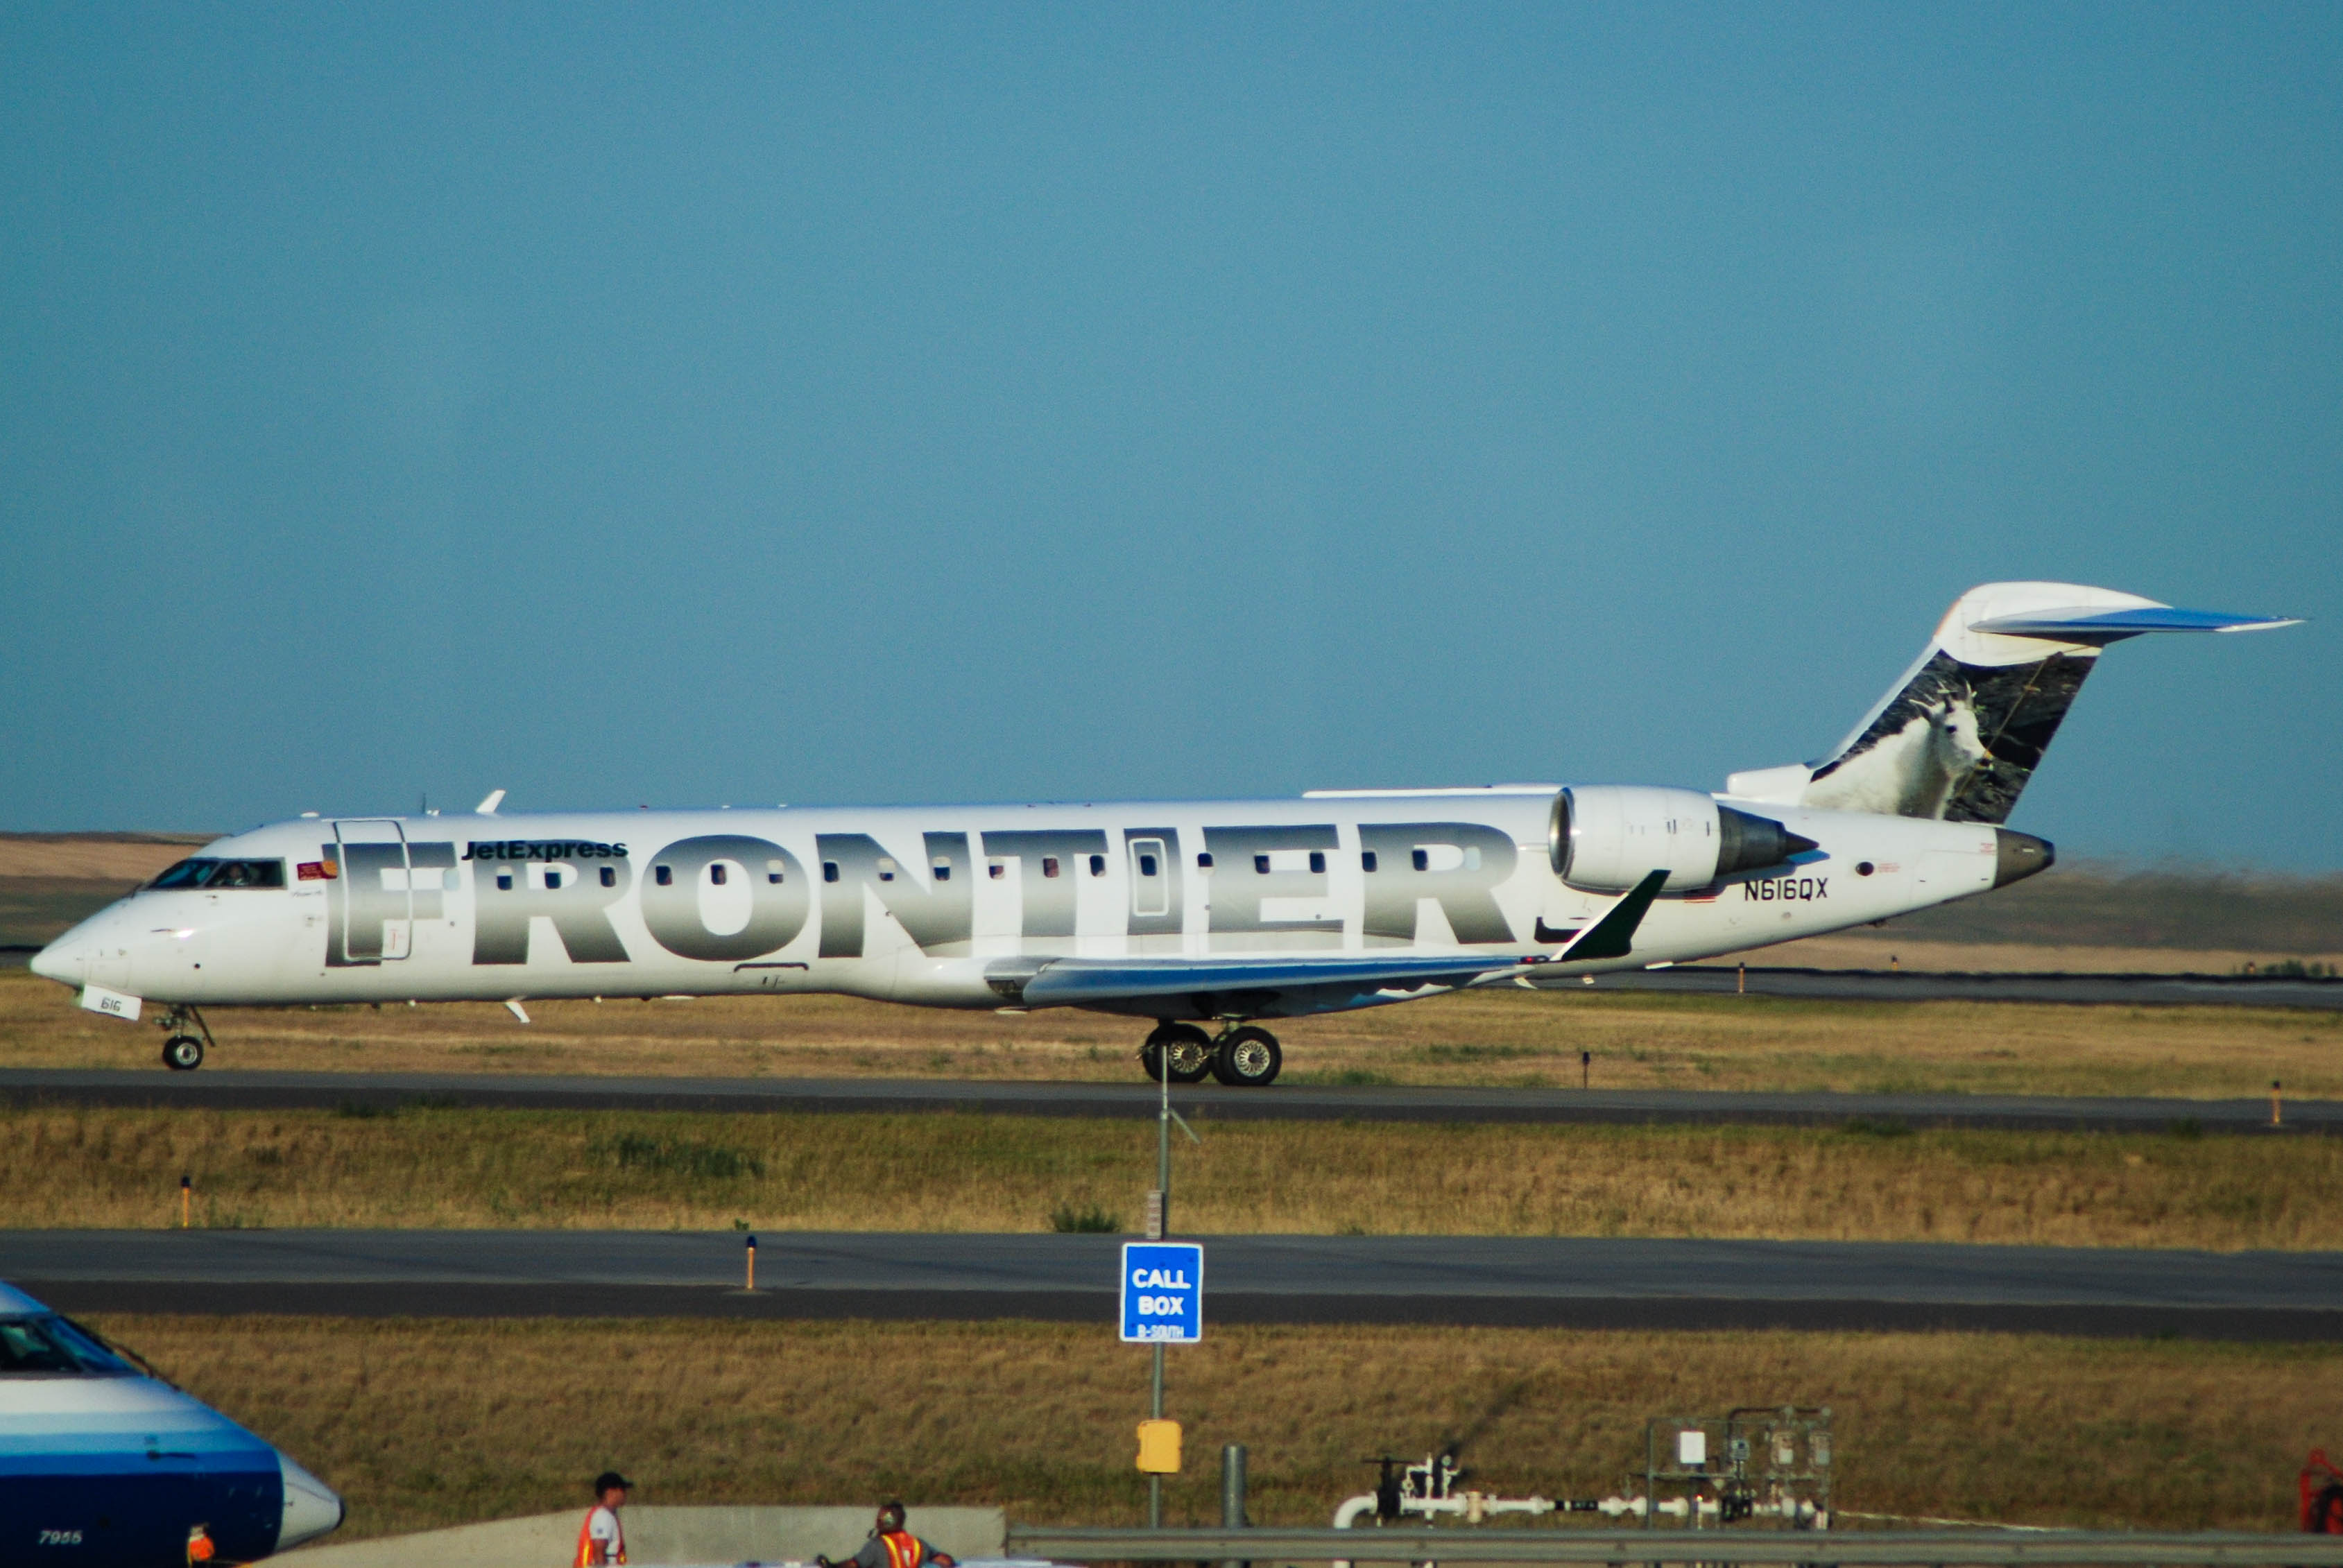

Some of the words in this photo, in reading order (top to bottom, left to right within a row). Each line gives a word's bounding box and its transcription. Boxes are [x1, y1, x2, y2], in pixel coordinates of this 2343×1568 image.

[461, 839, 628, 863] JetExpress
[322, 822, 1518, 967] FRONTIER
[1744, 877, 1828, 901] N616QX
[101, 997, 121, 1012] 616
[1132, 1268, 1192, 1289] CALL
[1138, 1295, 1184, 1316] BOX
